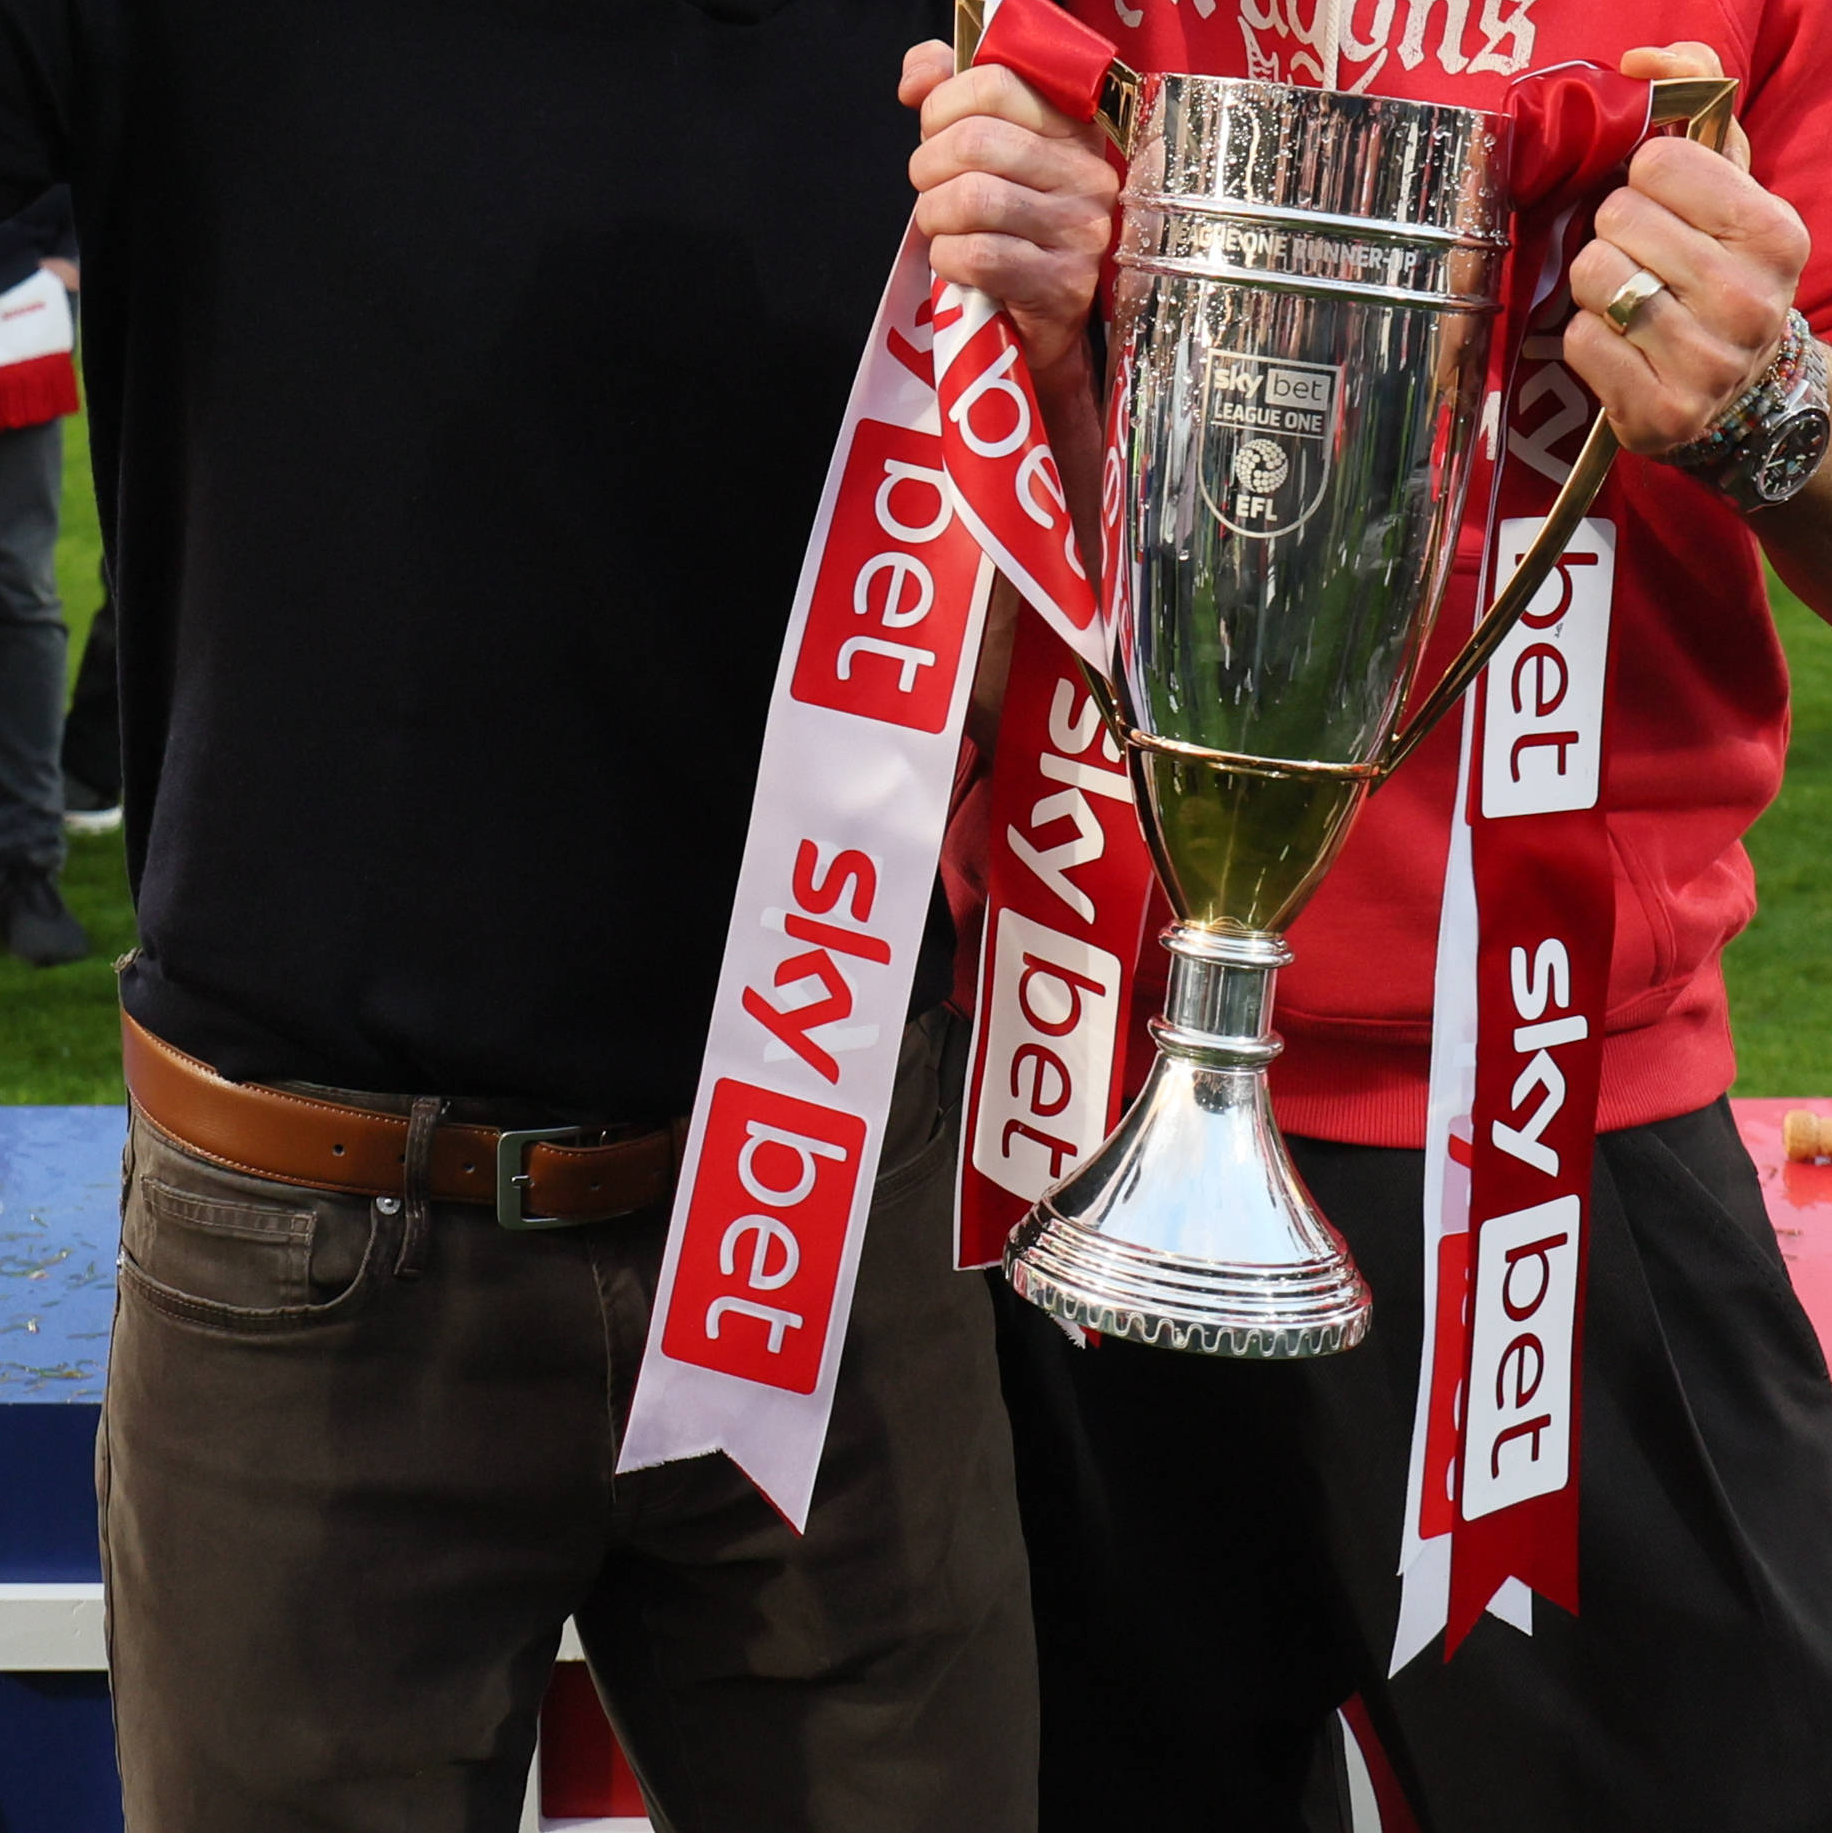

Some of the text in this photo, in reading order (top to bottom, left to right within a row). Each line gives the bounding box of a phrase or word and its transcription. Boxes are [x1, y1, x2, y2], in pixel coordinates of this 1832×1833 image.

[1242, 230, 1288, 257] ONE
[1213, 363, 1322, 401] sky bet
[1214, 402, 1323, 432] LEAGUE ONE
[836, 457, 954, 694] bet
[1235, 493, 1278, 521] EFL
[1510, 551, 1599, 783] bet
[1002, 677, 1135, 1179] sky bet
[704, 838, 892, 1355] sky bet
[1490, 937, 1588, 1481] sky bet
